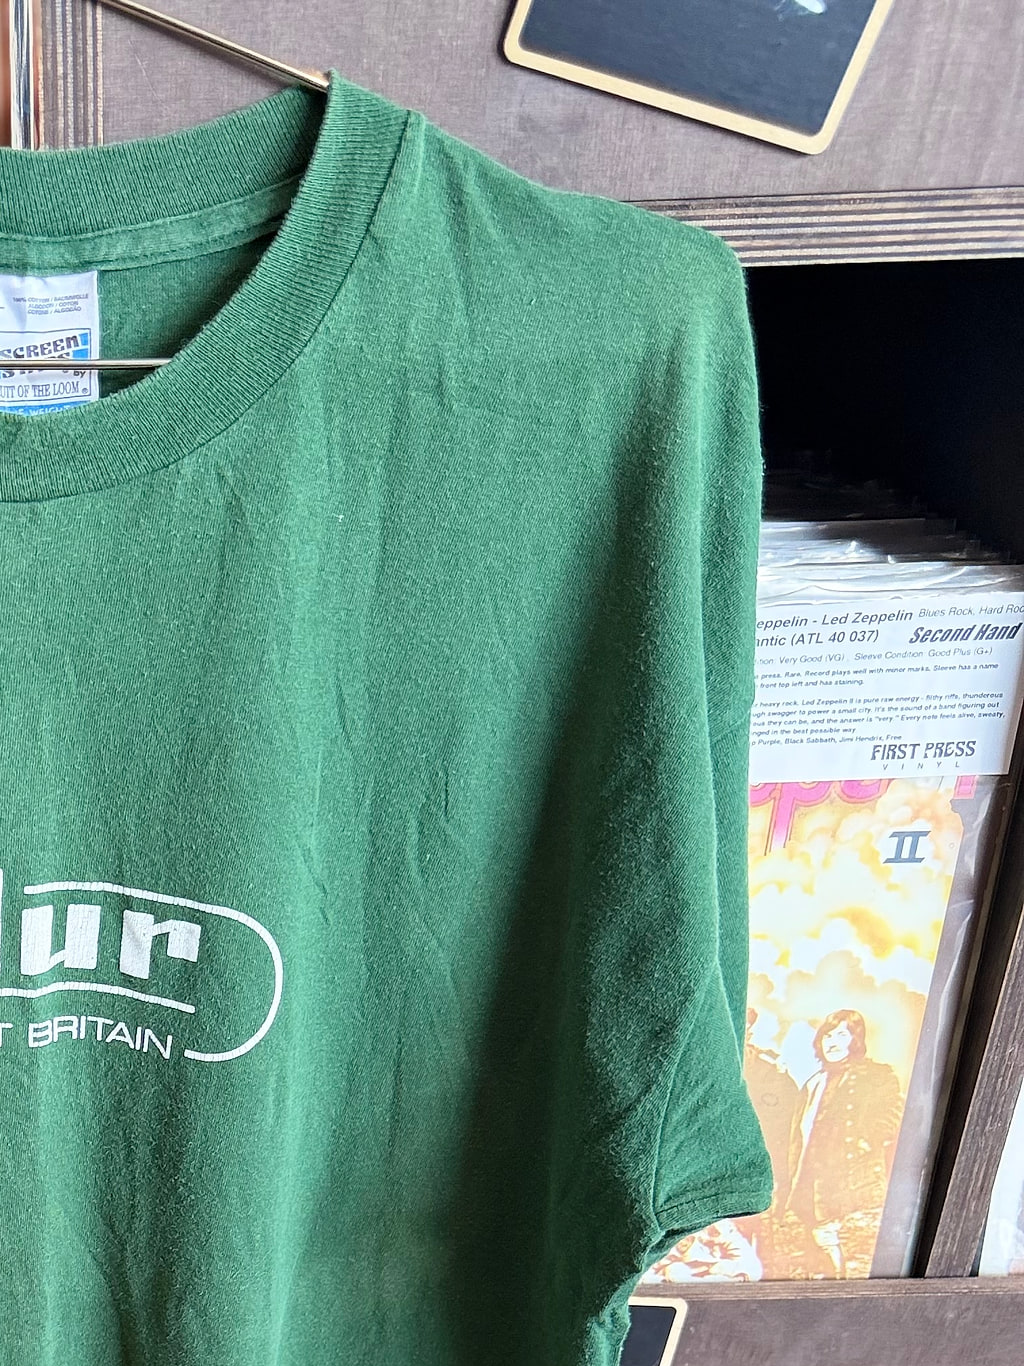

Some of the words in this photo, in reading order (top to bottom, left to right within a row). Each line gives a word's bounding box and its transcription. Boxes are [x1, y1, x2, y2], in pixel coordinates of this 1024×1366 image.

[17, 384, 30, 398] OF
[31, 383, 51, 398] THE
[52, 381, 80, 397] LOOM
[821, 612, 849, 625] Led
[851, 609, 913, 625] Zeppelin
[918, 608, 946, 618] Blues
[948, 606, 975, 616] Rock,
[979, 605, 1004, 615] Hard
[791, 632, 823, 647] (ATL
[827, 631, 845, 643] 40
[849, 629, 879, 643] 037)
[908, 624, 977, 644] Second
[973, 622, 1023, 640] Hand
[779, 656, 798, 665] Very
[799, 654, 823, 663] Good
[854, 652, 883, 661] Sleeve
[928, 648, 952, 657] Good
[953, 647, 972, 656] Plus
[973, 646, 993, 656] (G+)
[804, 668, 831, 677] Record
[831, 669, 851, 677] plays
[817, 697, 847, 705] Zeppelin
[810, 727, 840, 735] possible
[870, 743, 921, 760] FIRST
[923, 740, 977, 758] PRESS
[882, 830, 932, 864] II
[27, 1014, 173, 1060] BRITAIN
